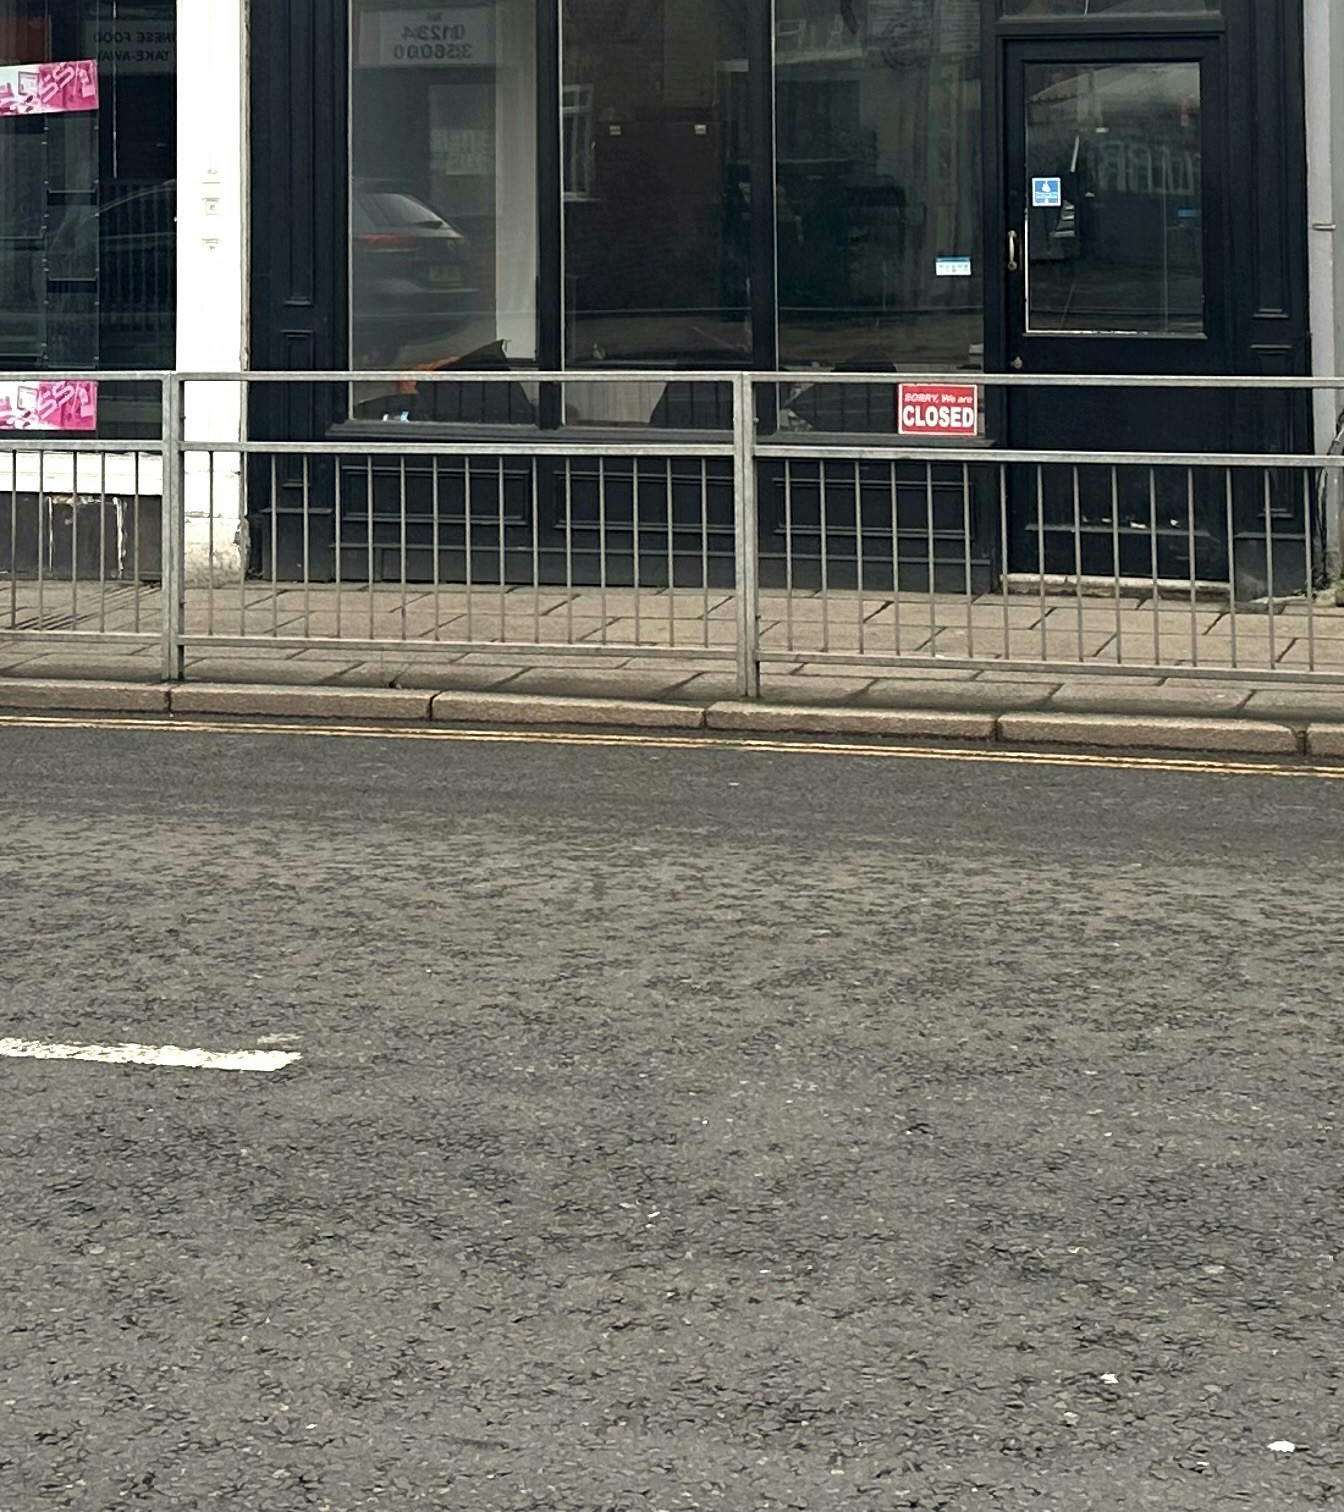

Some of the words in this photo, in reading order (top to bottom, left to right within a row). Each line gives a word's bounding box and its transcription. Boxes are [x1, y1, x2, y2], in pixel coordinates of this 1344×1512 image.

[941, 393, 957, 404] We
[957, 396, 973, 404] are
[902, 404, 975, 428] CLOSED
